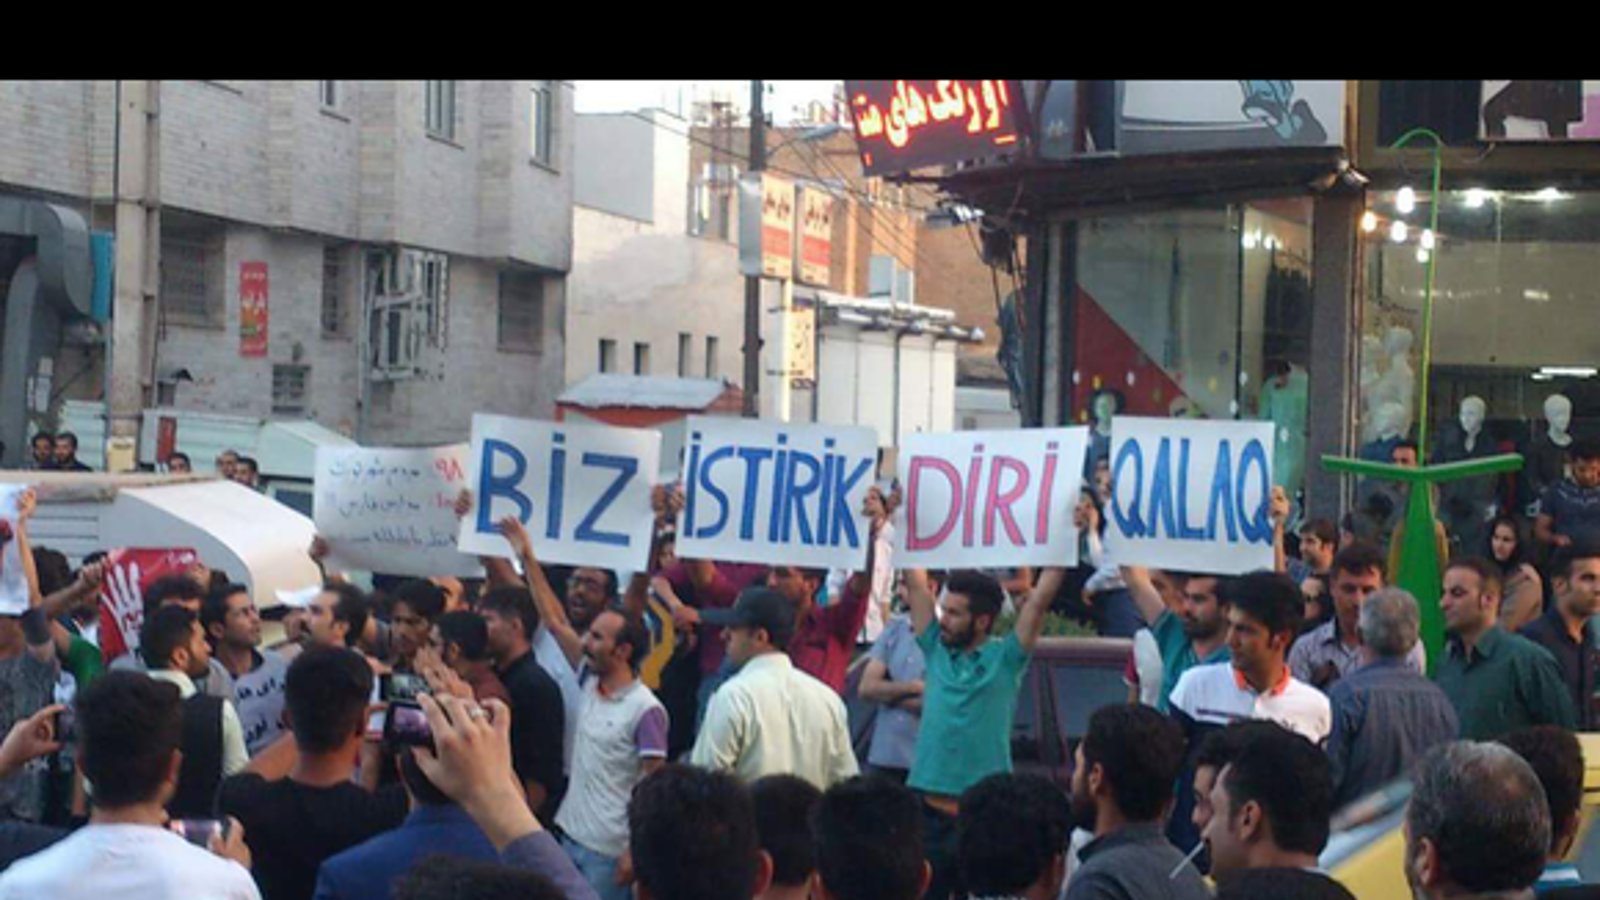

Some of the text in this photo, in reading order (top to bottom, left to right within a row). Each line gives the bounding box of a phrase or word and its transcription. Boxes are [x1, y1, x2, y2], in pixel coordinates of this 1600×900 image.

[476, 432, 638, 546] BİZ
[683, 431, 872, 548] İSTİRİK
[906, 443, 1058, 551] DİRİ
[1111, 437, 1273, 545] QALAQ
